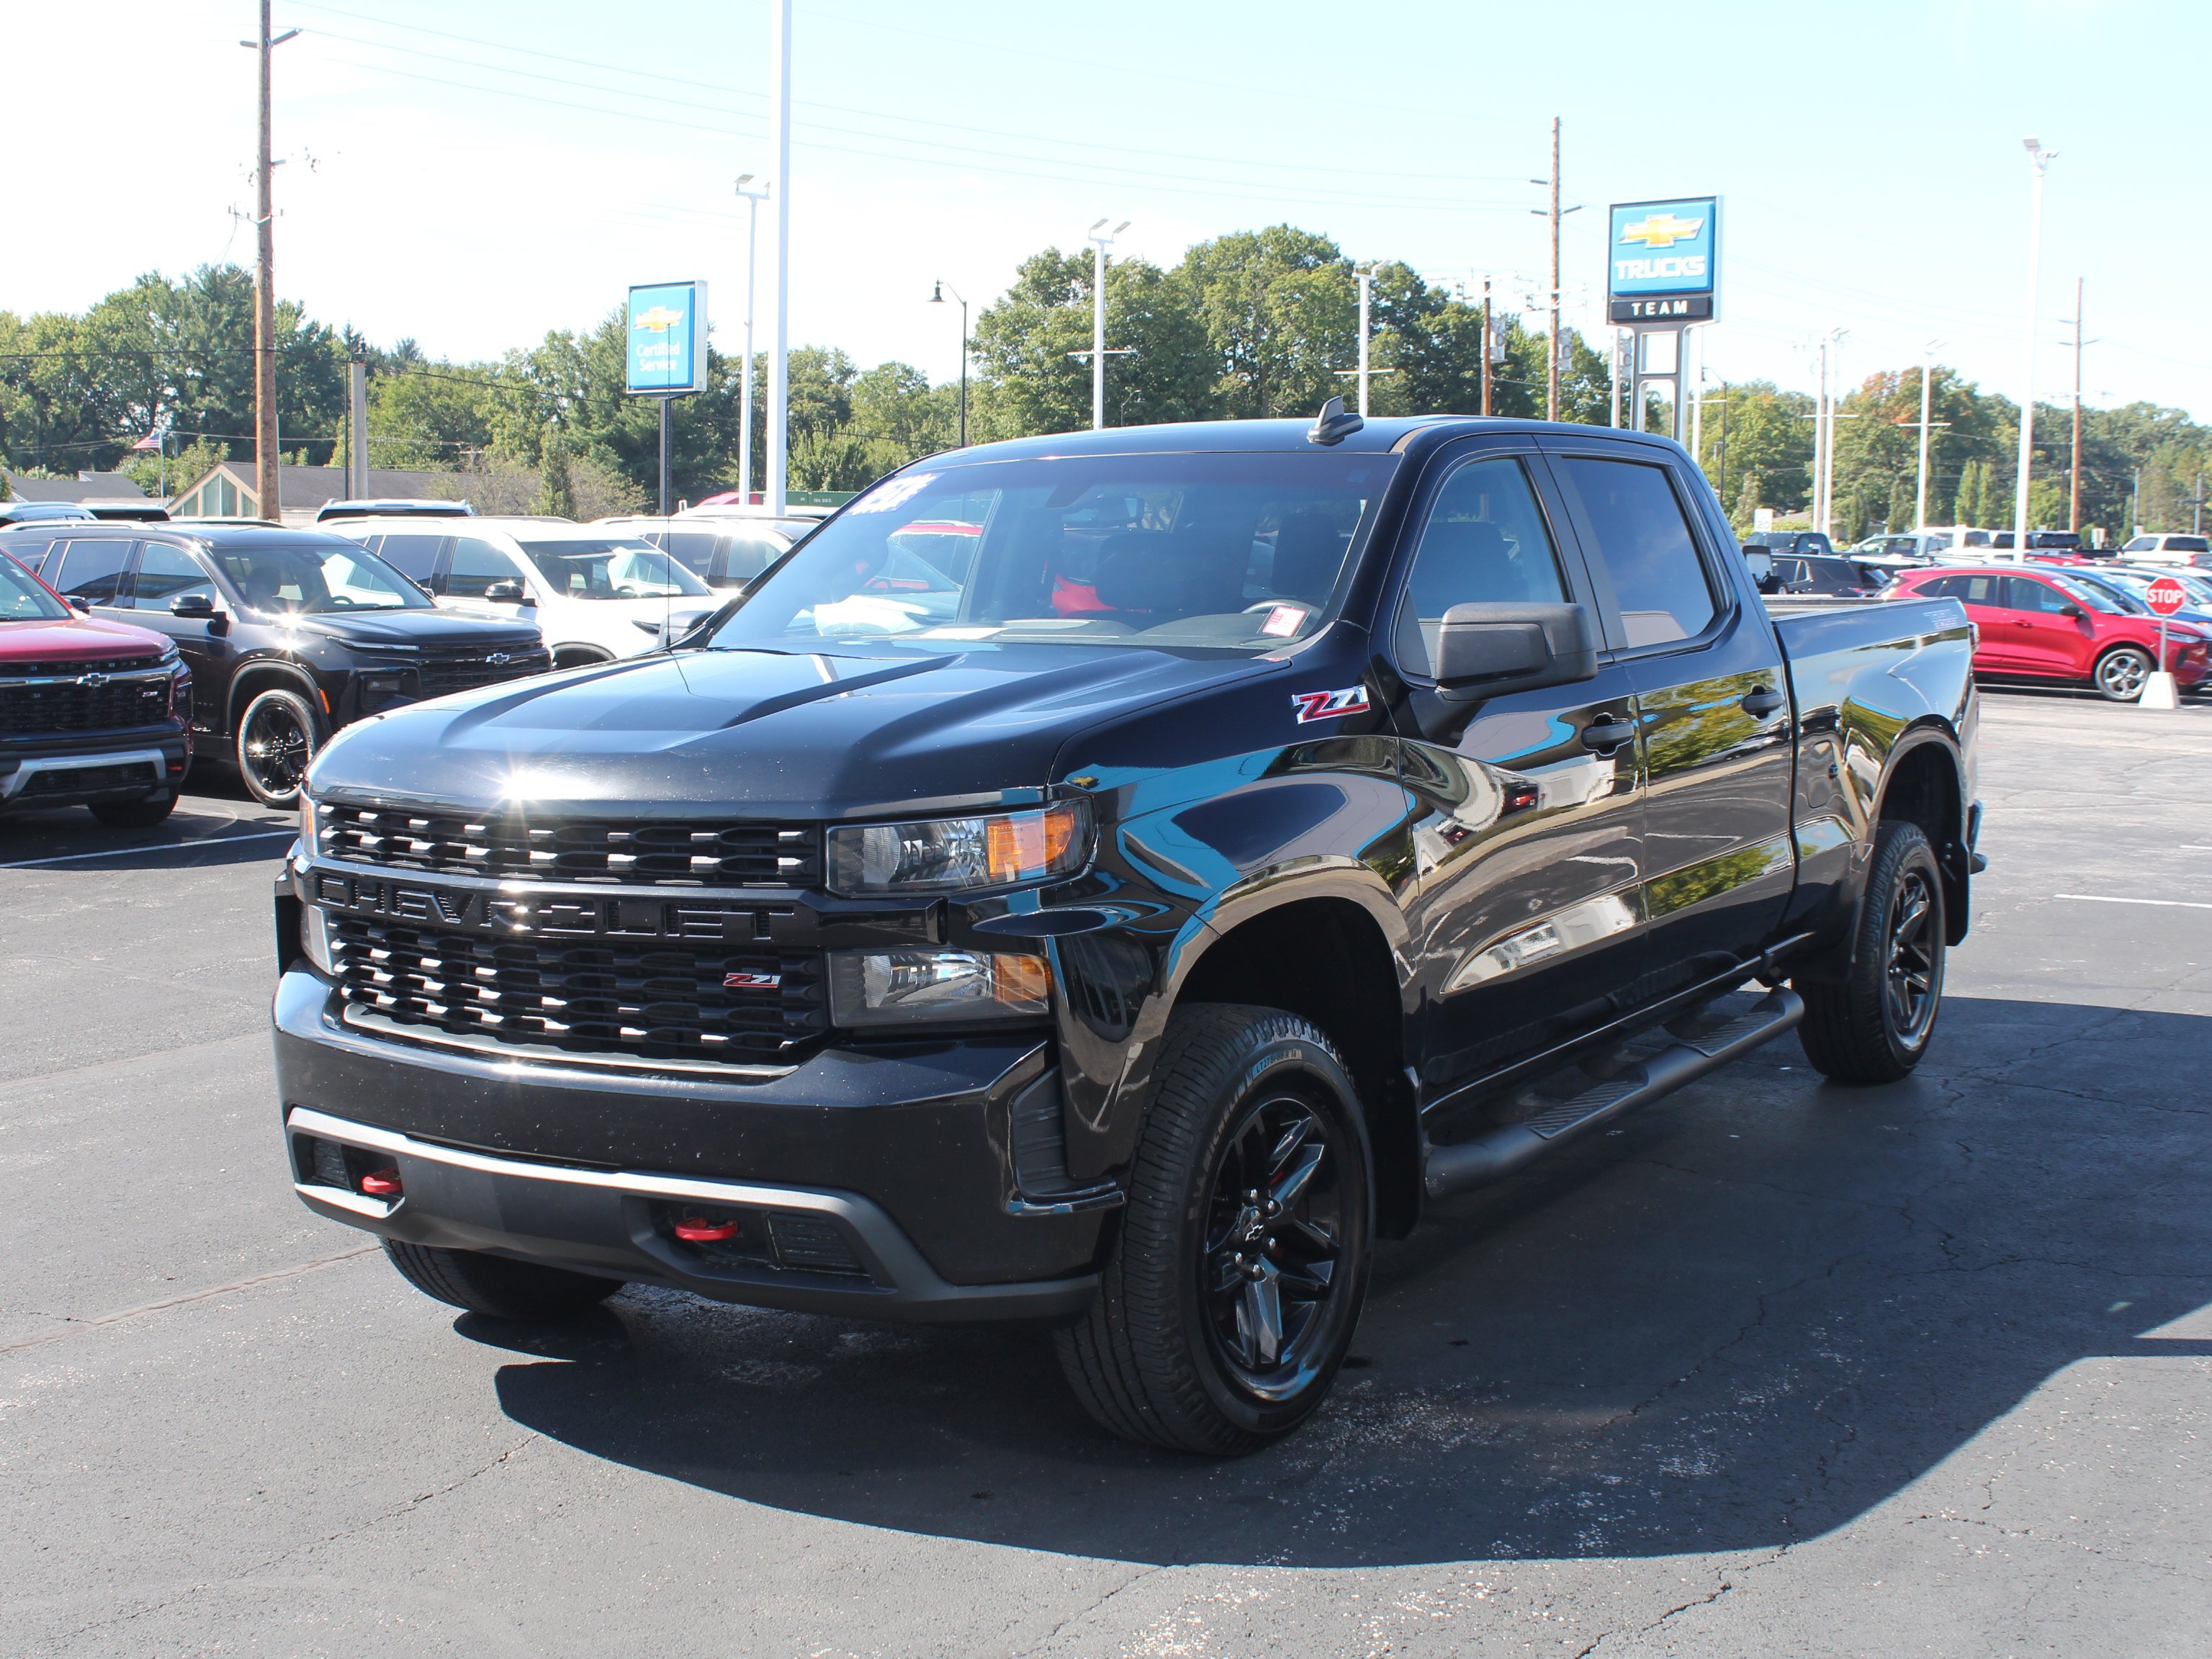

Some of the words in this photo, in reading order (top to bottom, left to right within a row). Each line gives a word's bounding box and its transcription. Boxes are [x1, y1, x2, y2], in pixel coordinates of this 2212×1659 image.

[1614, 255, 1706, 281] TRUCKS
[1631, 300, 1688, 316] TEAM
[636, 341, 680, 358] Certified
[639, 358, 677, 372] Service
[2147, 589, 2182, 603] STOP
[1291, 684, 1371, 724] Z71
[315, 872, 794, 940] CHEVROLET
[723, 973, 781, 989] Z71
